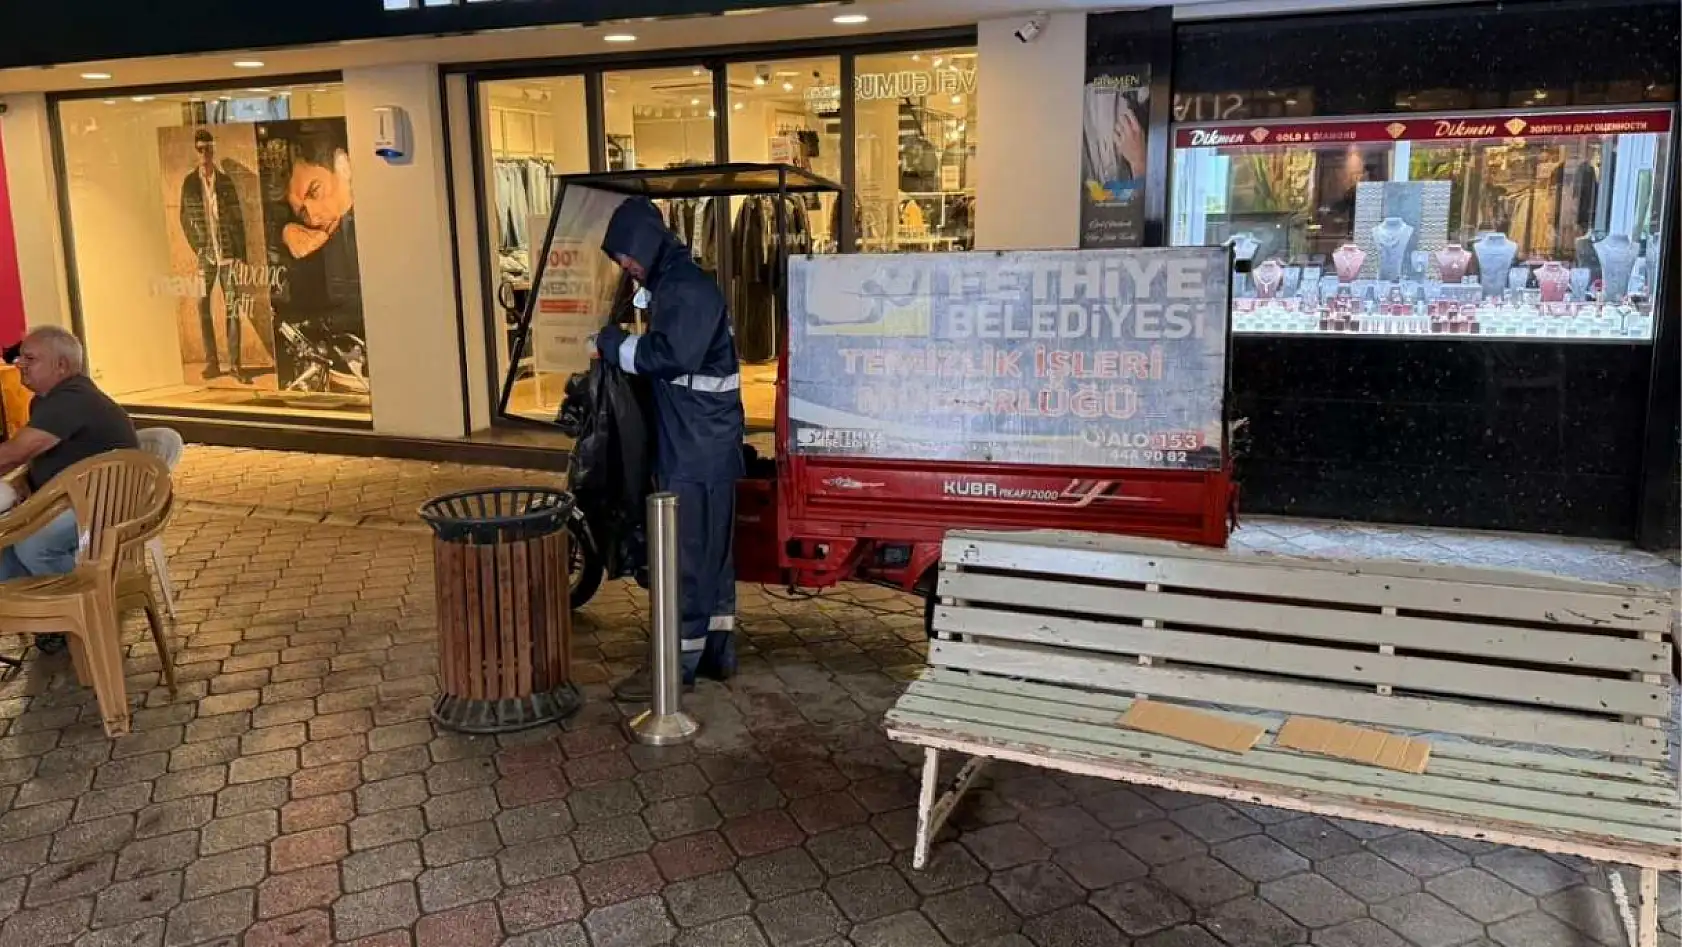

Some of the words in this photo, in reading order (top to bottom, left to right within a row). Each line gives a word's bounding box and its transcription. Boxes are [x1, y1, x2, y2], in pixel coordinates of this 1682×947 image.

[1188, 130, 1245, 146] Dikmen
[1276, 132, 1301, 142] GOLD
[1106, 433, 1150, 448] ALO
[1160, 433, 1198, 448] 153
[1143, 451, 1163, 462] 90
[1166, 451, 1187, 462] 82
